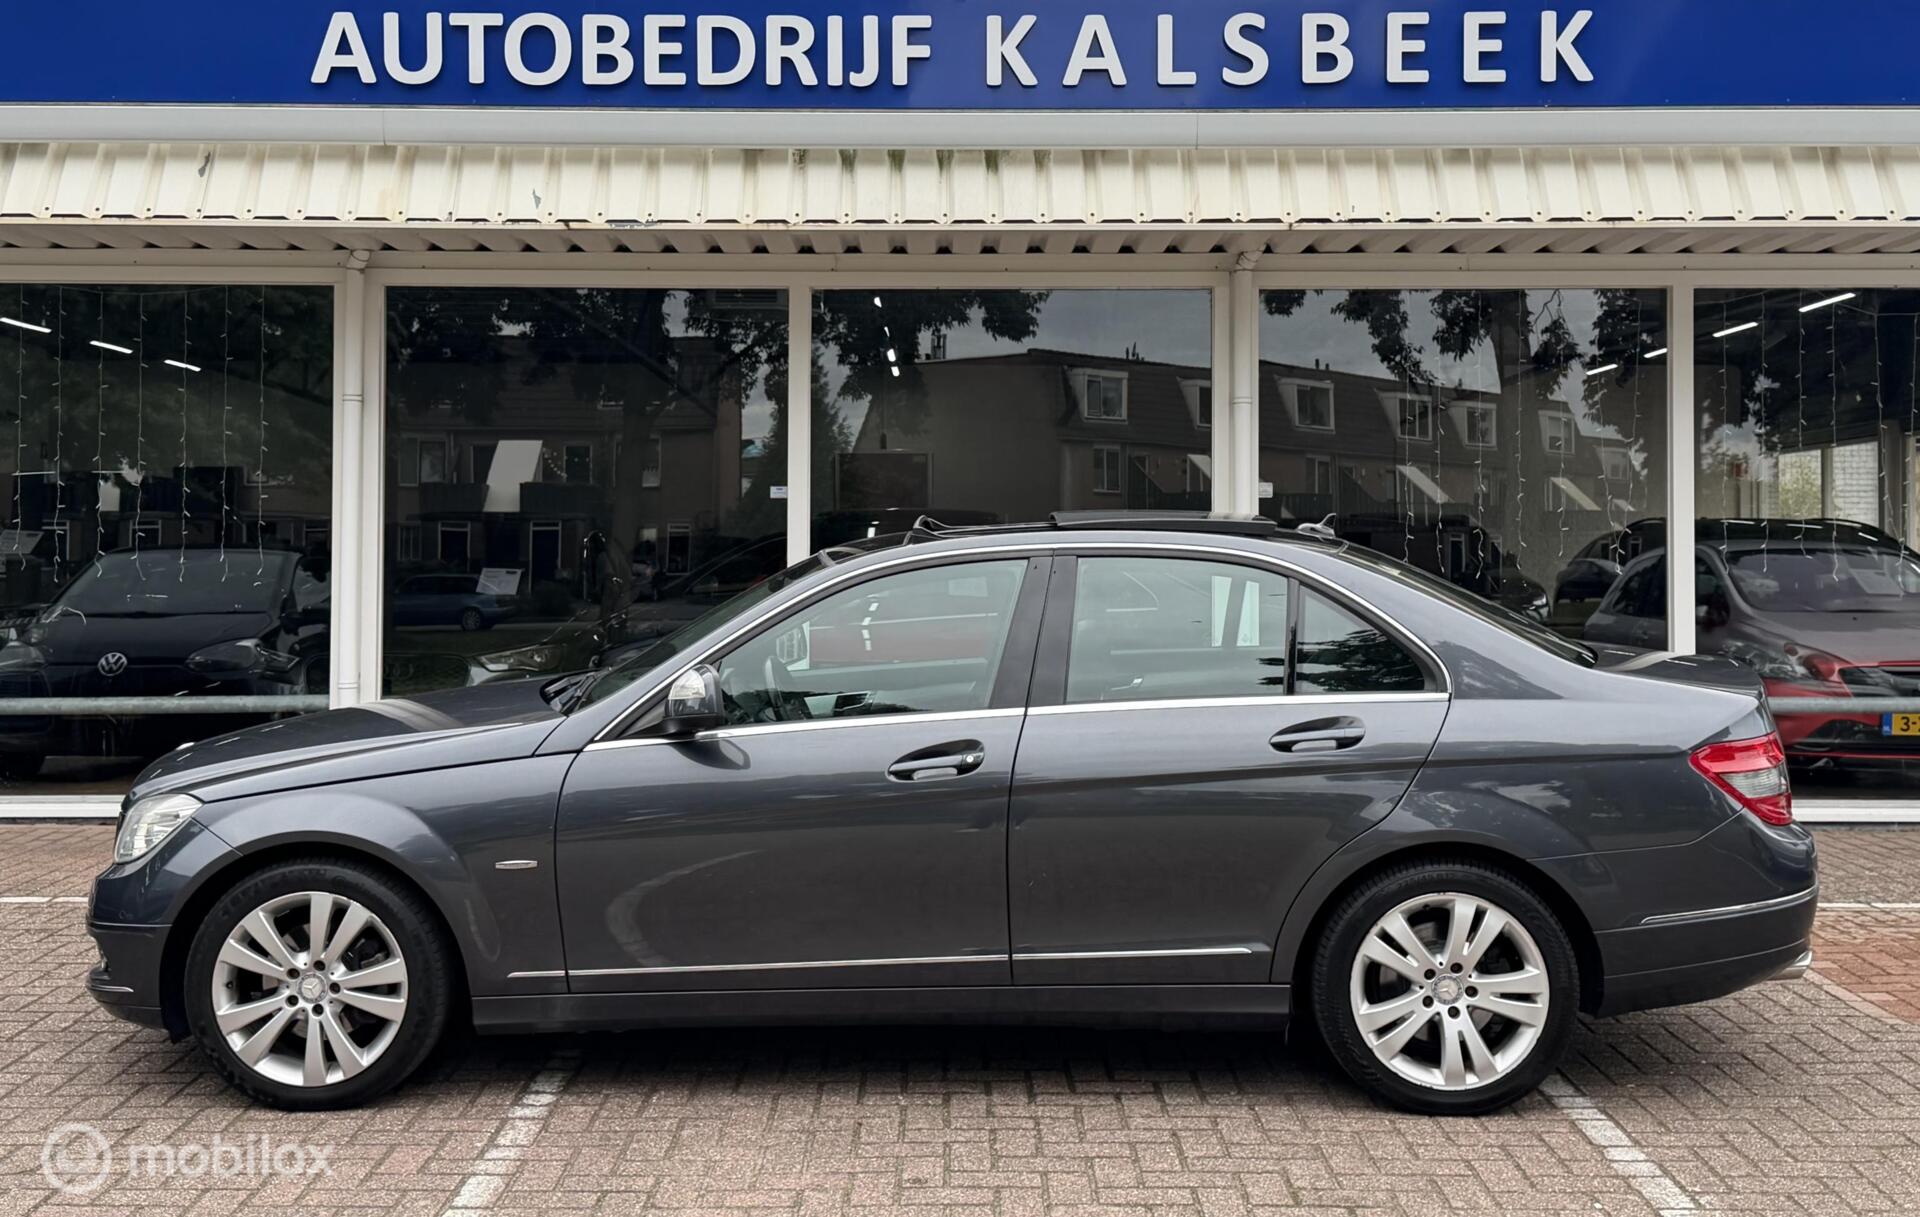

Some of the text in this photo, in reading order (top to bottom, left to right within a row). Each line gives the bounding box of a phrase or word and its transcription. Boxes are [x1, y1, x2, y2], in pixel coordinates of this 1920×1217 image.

[310, 9, 1595, 88] AUTOBEDRIJF KALSBEEK
[1900, 715, 1920, 733] 3-
